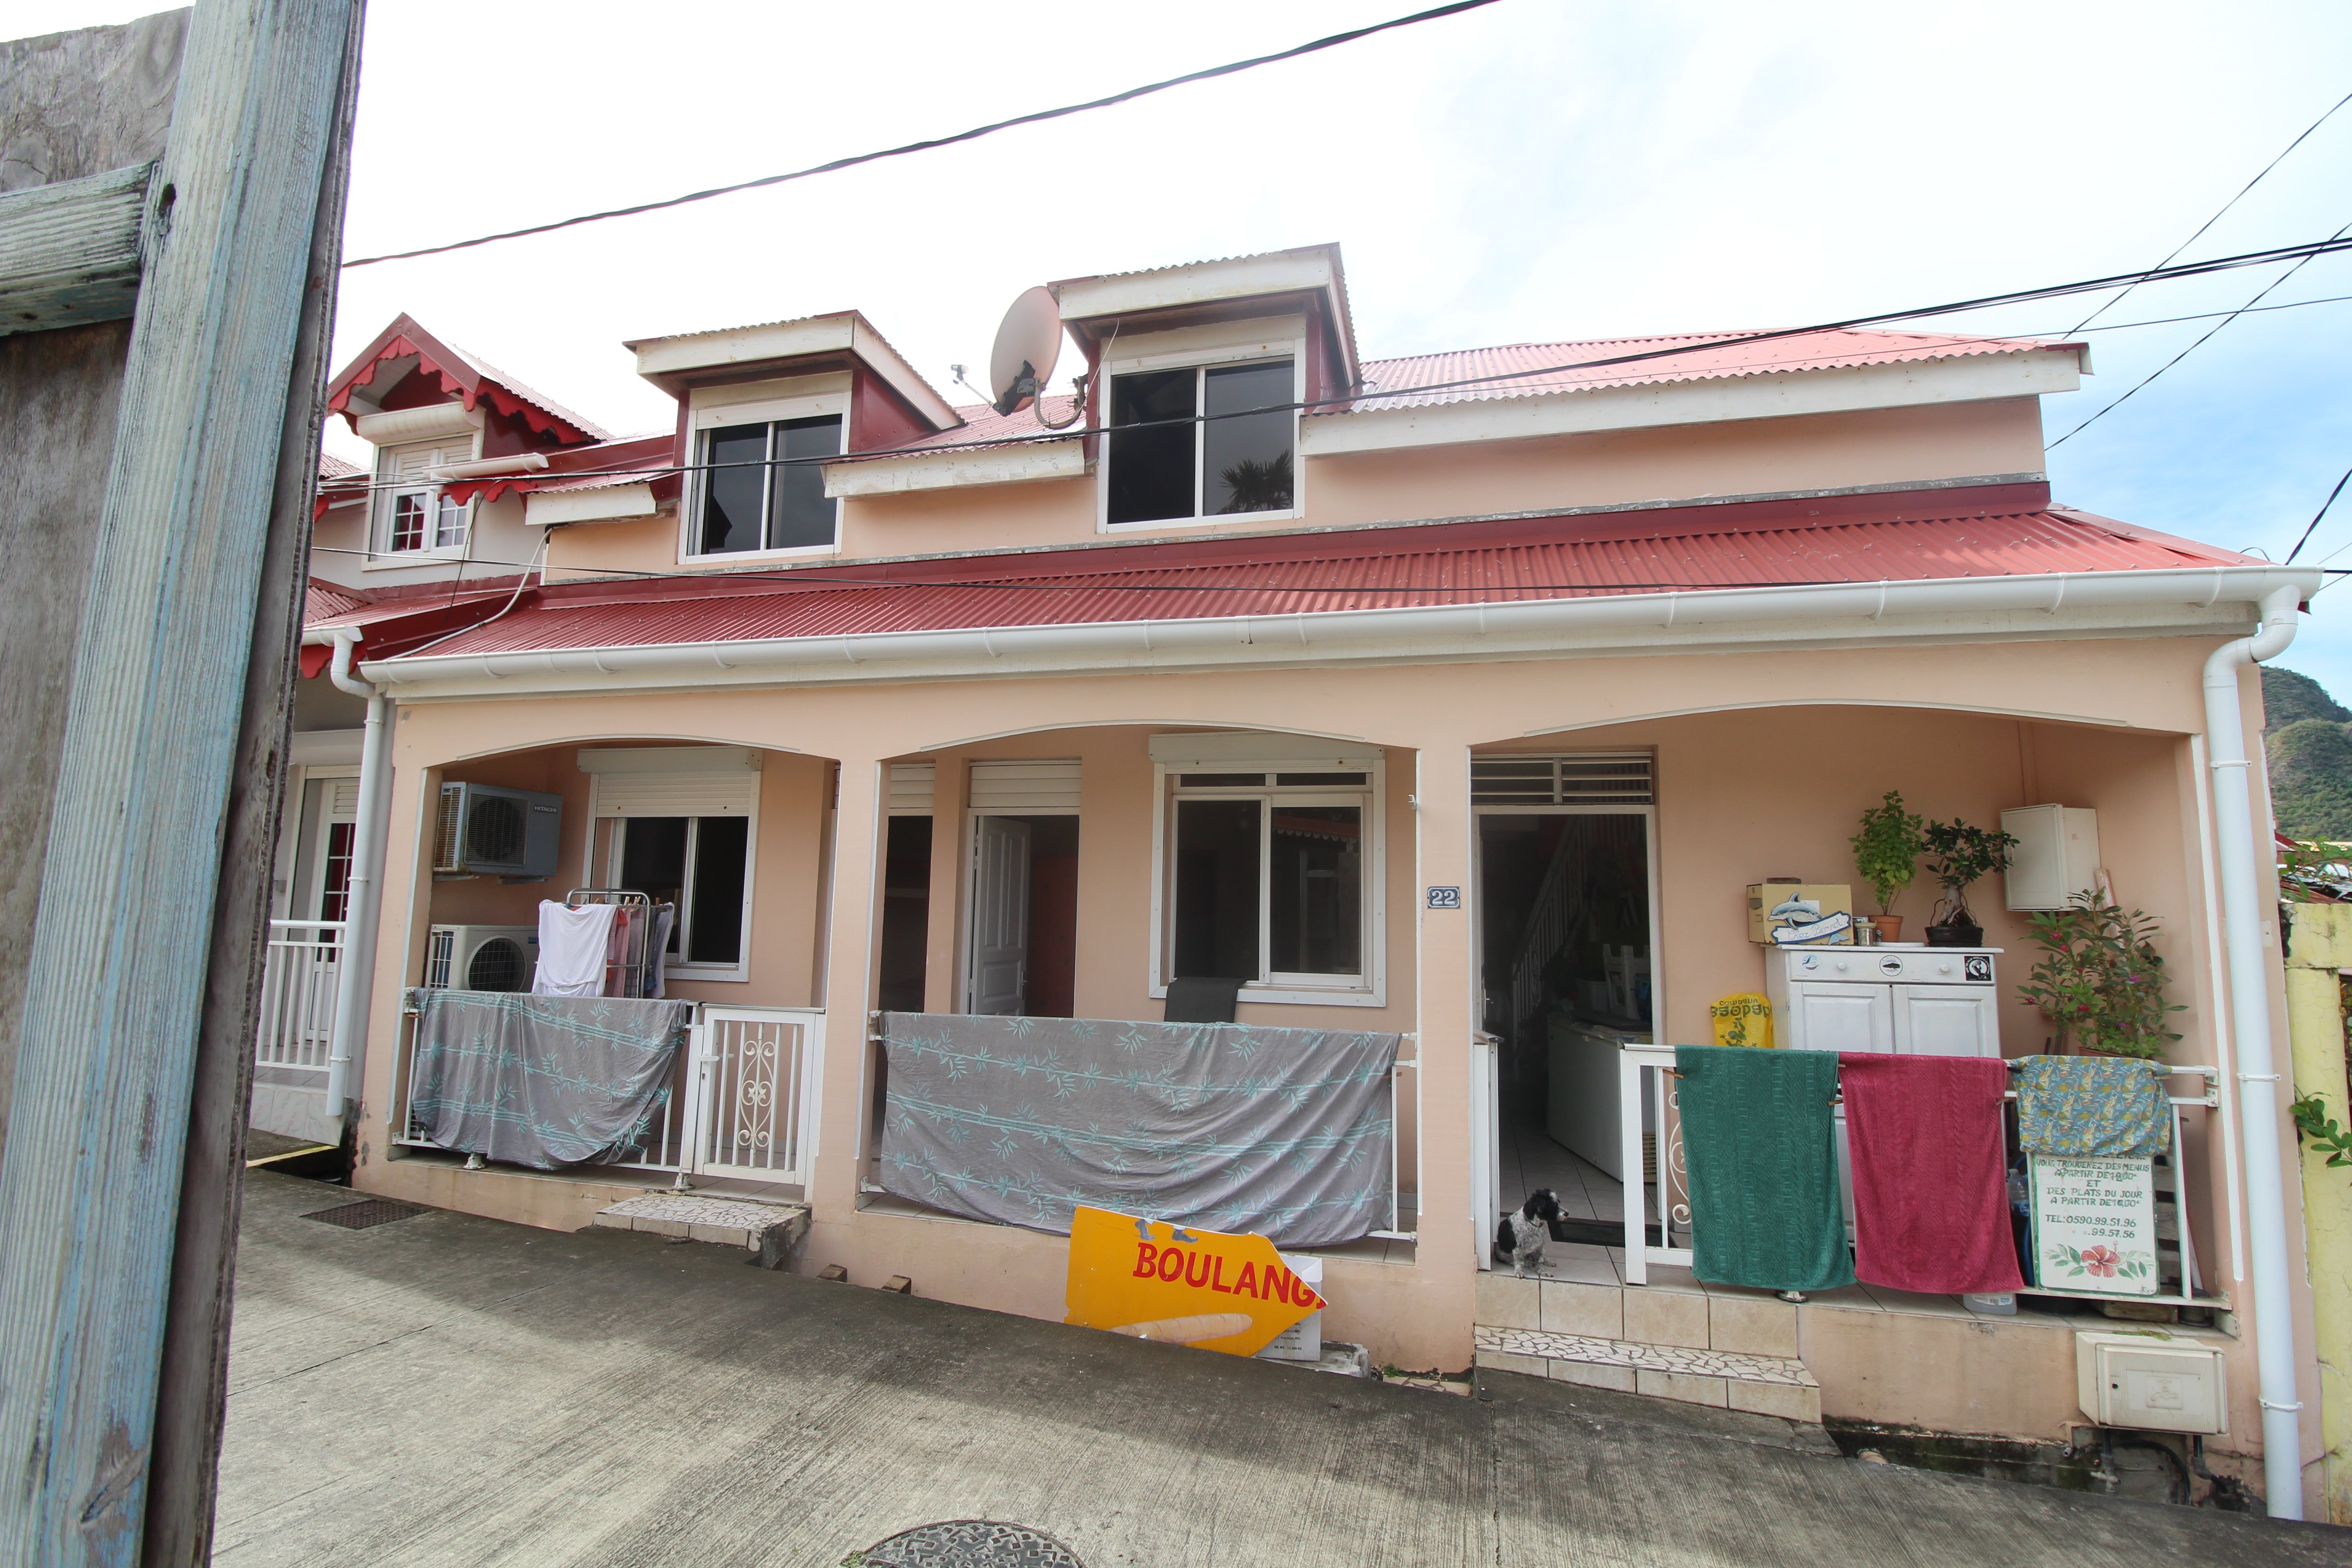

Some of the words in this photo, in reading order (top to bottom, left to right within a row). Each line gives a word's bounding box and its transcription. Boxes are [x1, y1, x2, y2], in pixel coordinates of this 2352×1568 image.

[1431, 890, 1455, 905] 22
[1787, 930, 1810, 940] Chez
[2071, 1188, 2101, 1197] PLATS
[2120, 1191, 2143, 1199] JOUR
